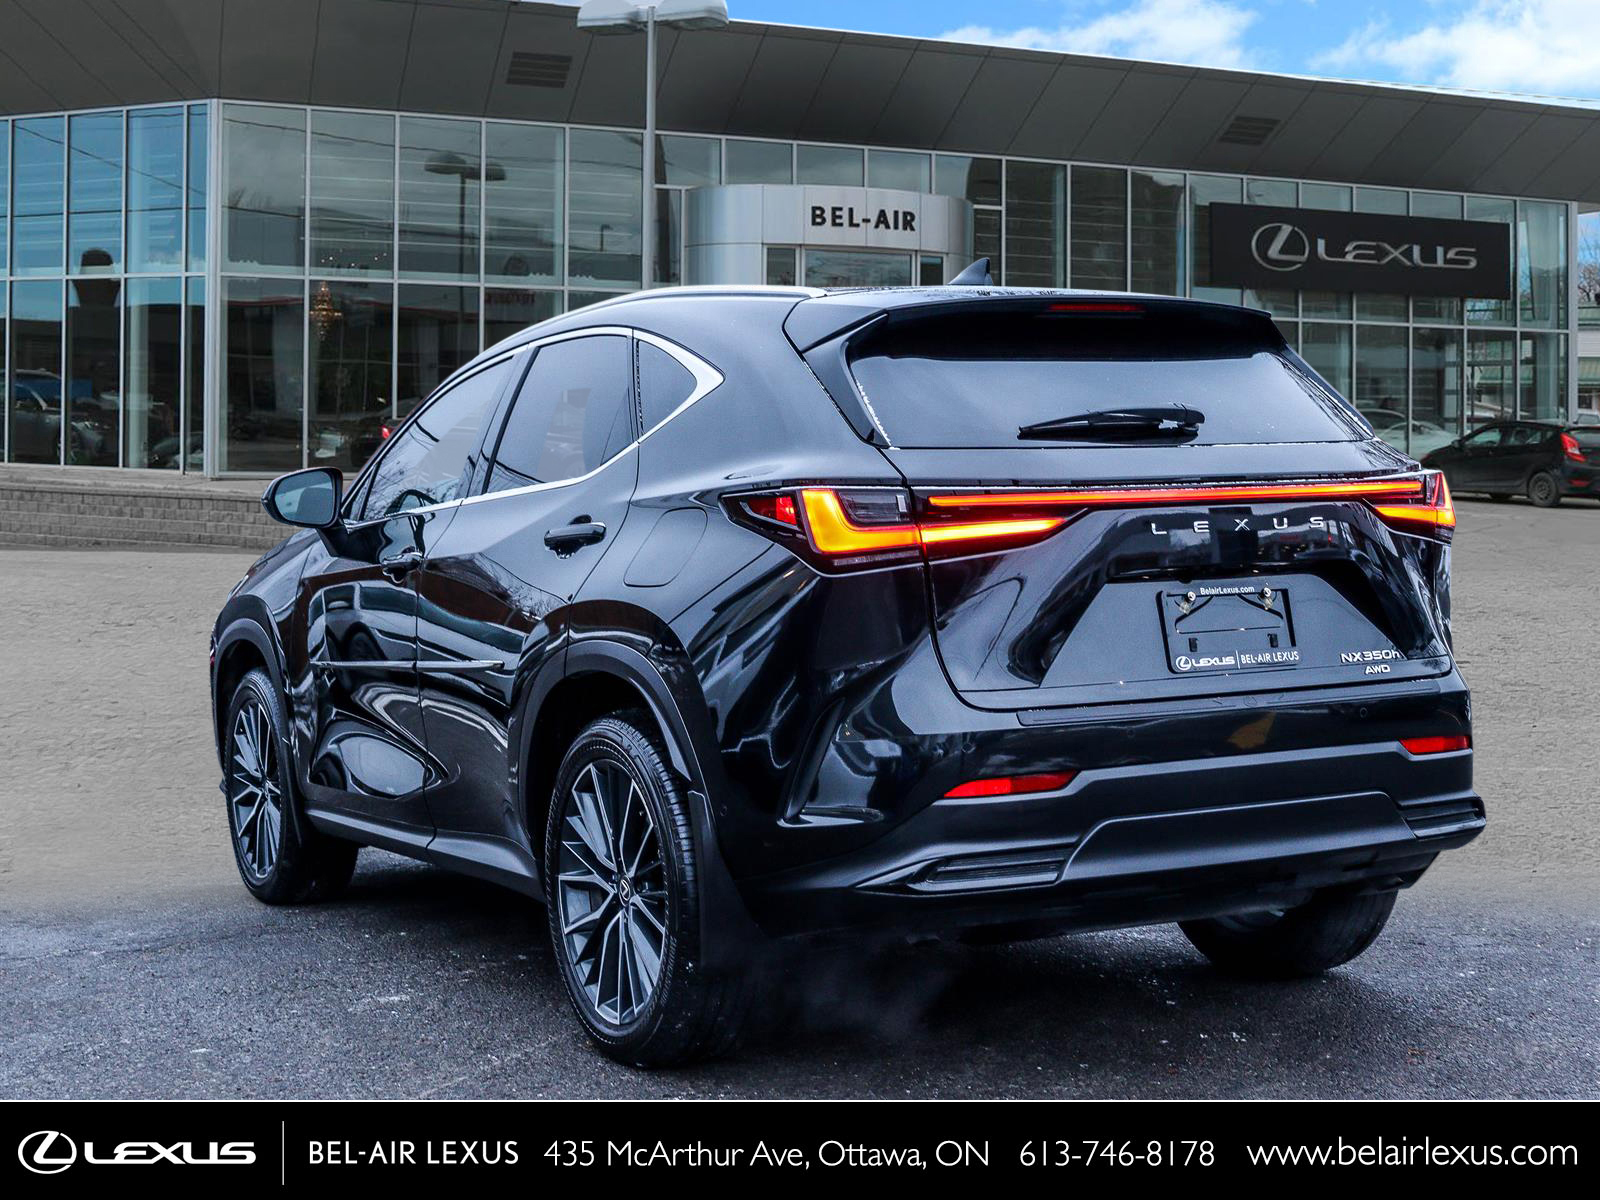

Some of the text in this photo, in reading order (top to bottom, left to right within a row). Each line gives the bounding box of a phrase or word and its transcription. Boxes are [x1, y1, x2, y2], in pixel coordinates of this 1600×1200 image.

[811, 205, 916, 231] BEL-AIR
[1317, 237, 1477, 269] LEXUS
[1151, 516, 1325, 535] LEXUS
[1200, 586, 1254, 595] BelairLexus.com
[1192, 656, 1235, 667] LEXUS
[1273, 651, 1299, 662] LEXUS
[1341, 650, 1400, 663] NX350h
[1365, 664, 1391, 675] AWD
